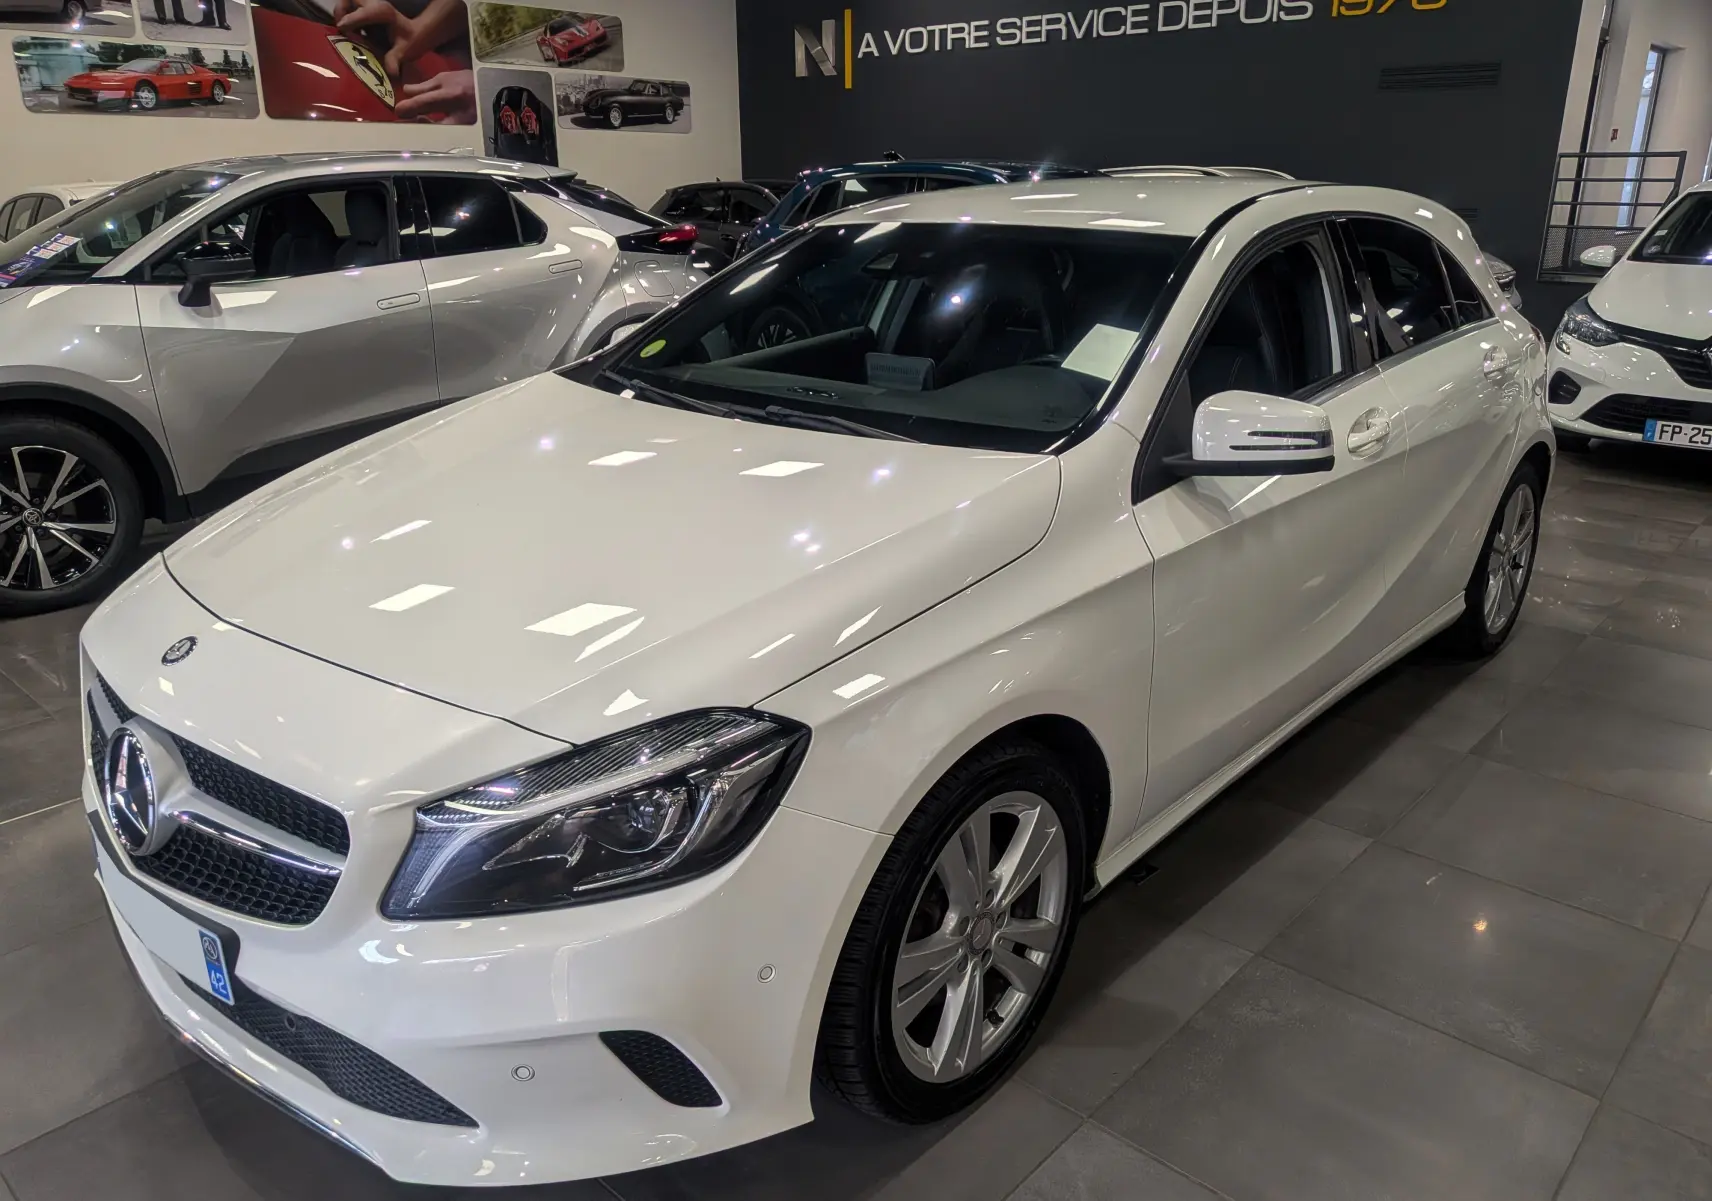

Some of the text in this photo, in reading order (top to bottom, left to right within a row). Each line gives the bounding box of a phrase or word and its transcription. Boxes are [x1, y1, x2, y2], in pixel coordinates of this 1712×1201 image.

[857, 32, 880, 59] A
[884, 20, 990, 56] VOTRE
[996, 4, 1150, 46] SERVICE
[1157, 0, 1314, 32] DEPUIS
[1658, 423, 1712, 446] FP-25
[210, 969, 228, 994] 42
